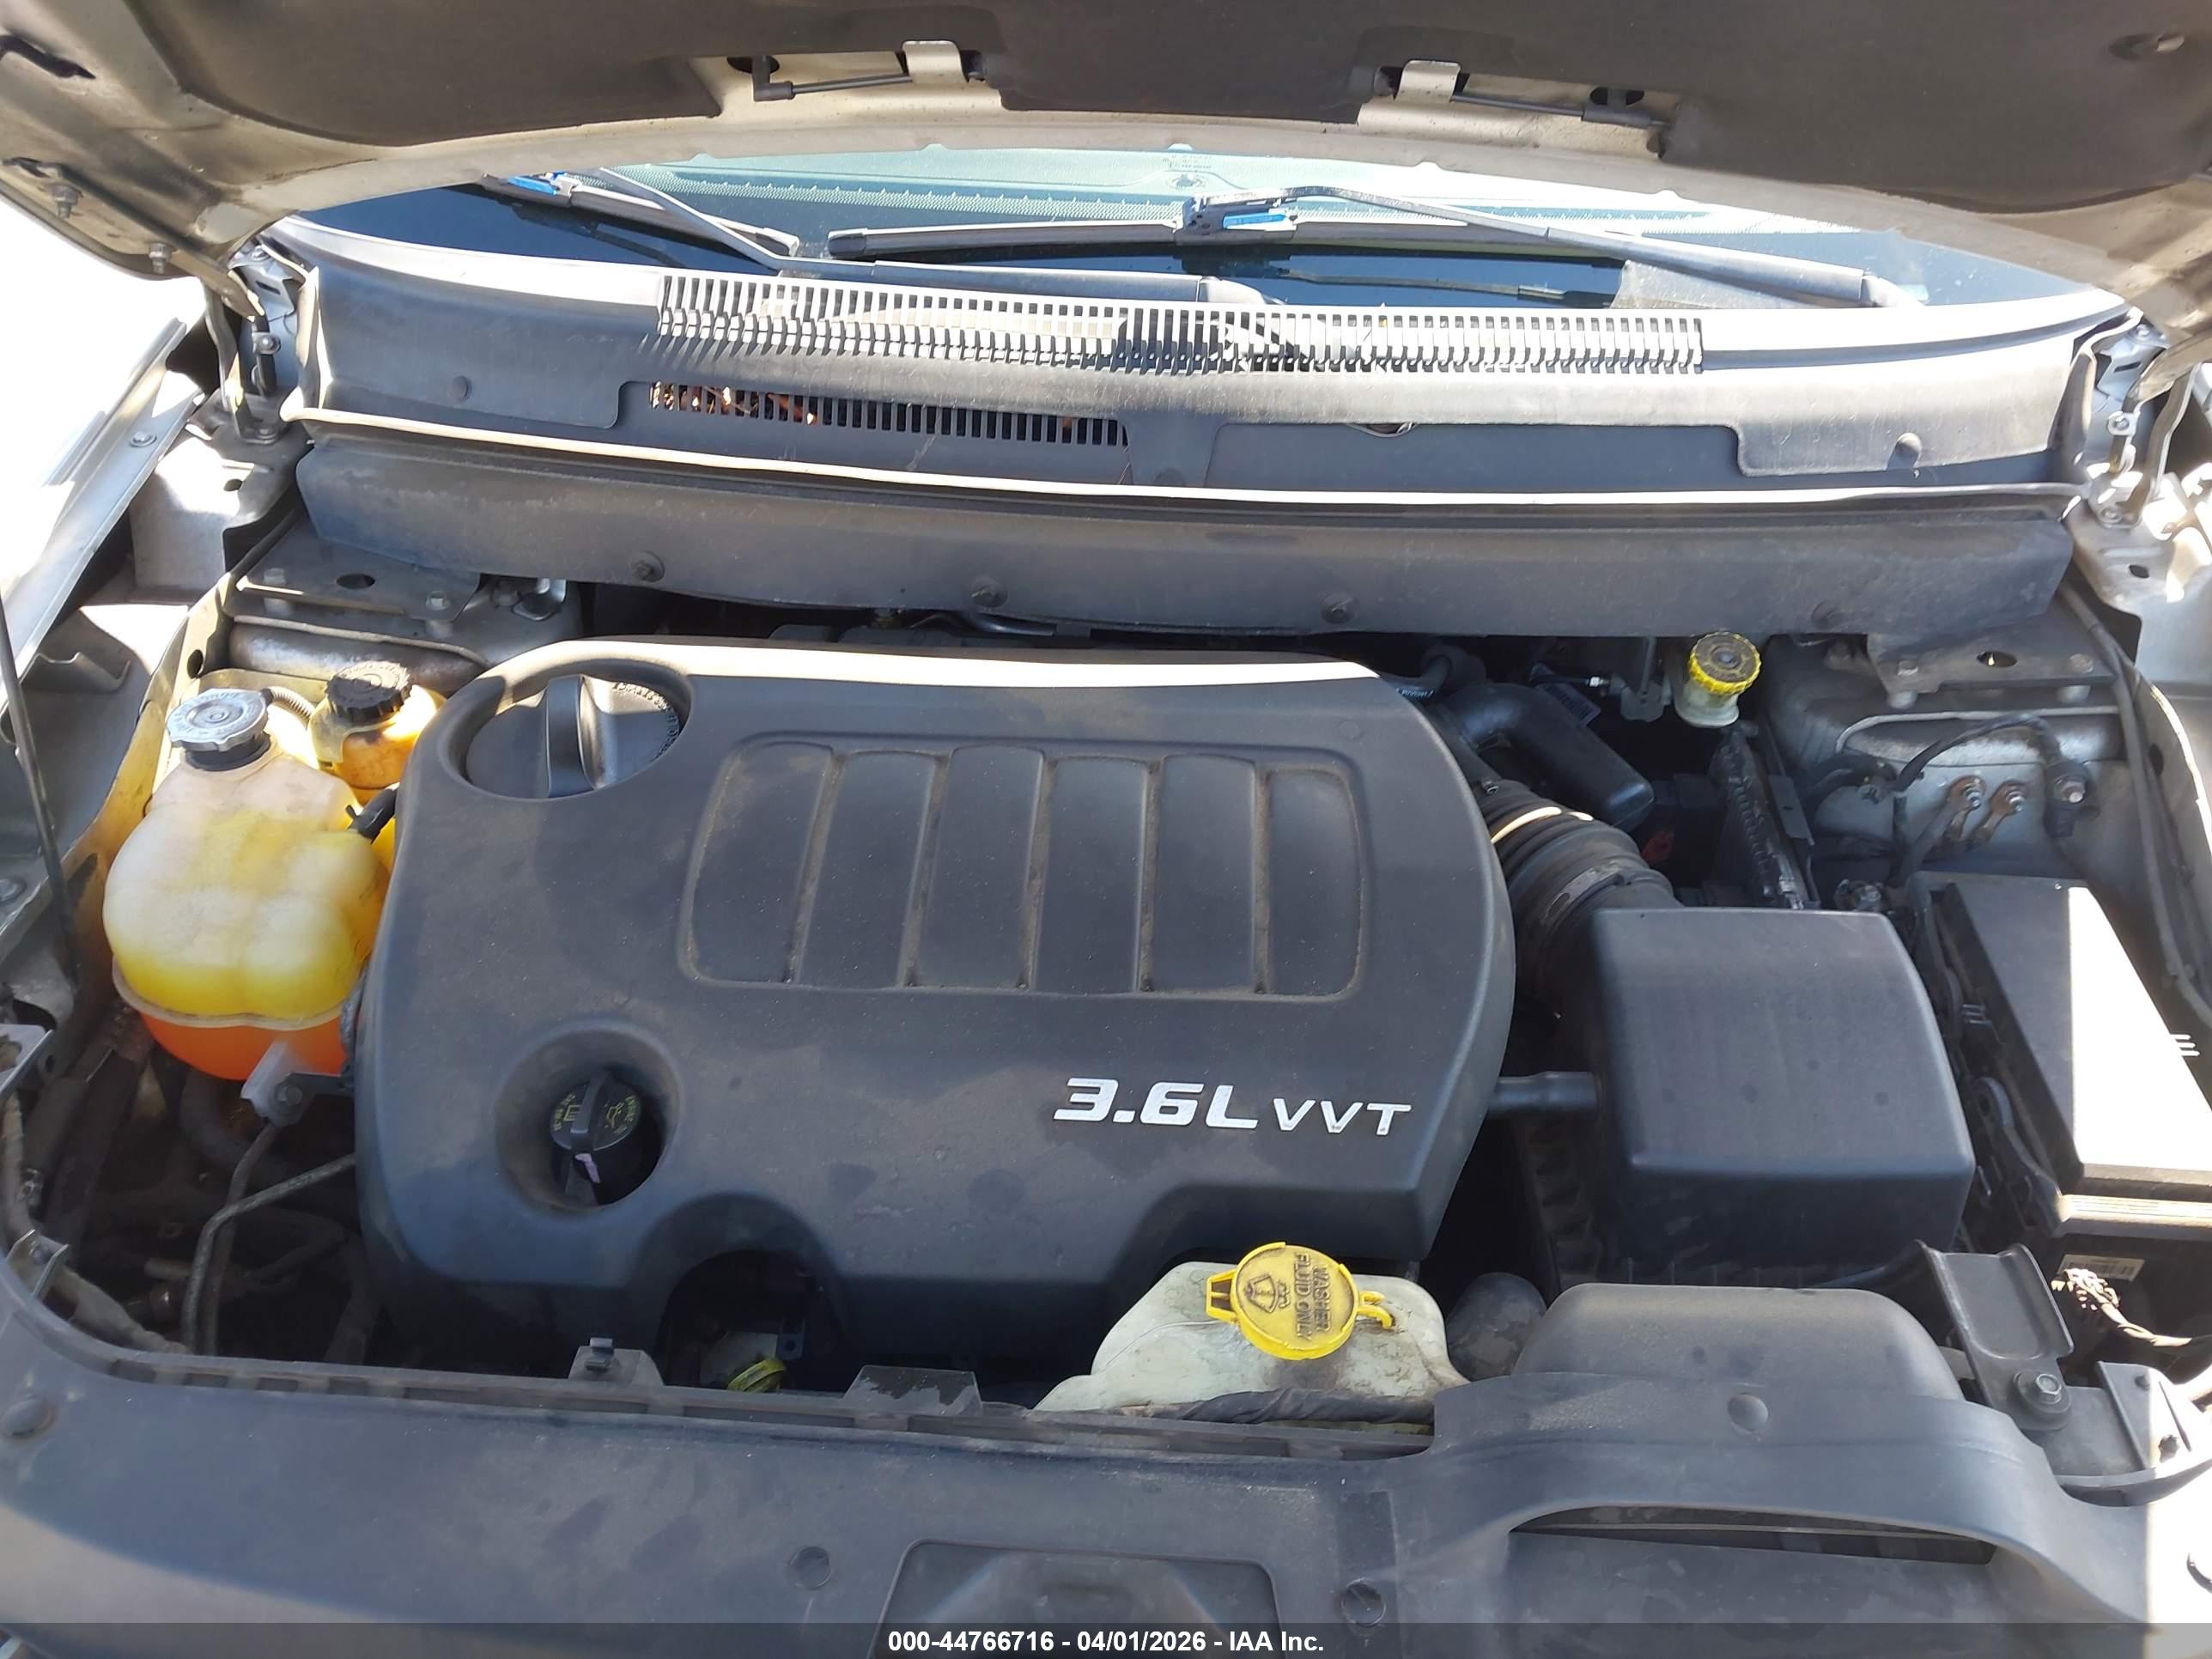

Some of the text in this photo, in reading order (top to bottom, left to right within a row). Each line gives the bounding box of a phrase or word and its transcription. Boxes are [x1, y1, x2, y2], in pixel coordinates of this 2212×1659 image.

[1054, 1077, 1412, 1135] 3.6L VVT
[1295, 1253, 1312, 1340] FLUID ONLY
[1313, 1265, 1331, 1332] WASHER
